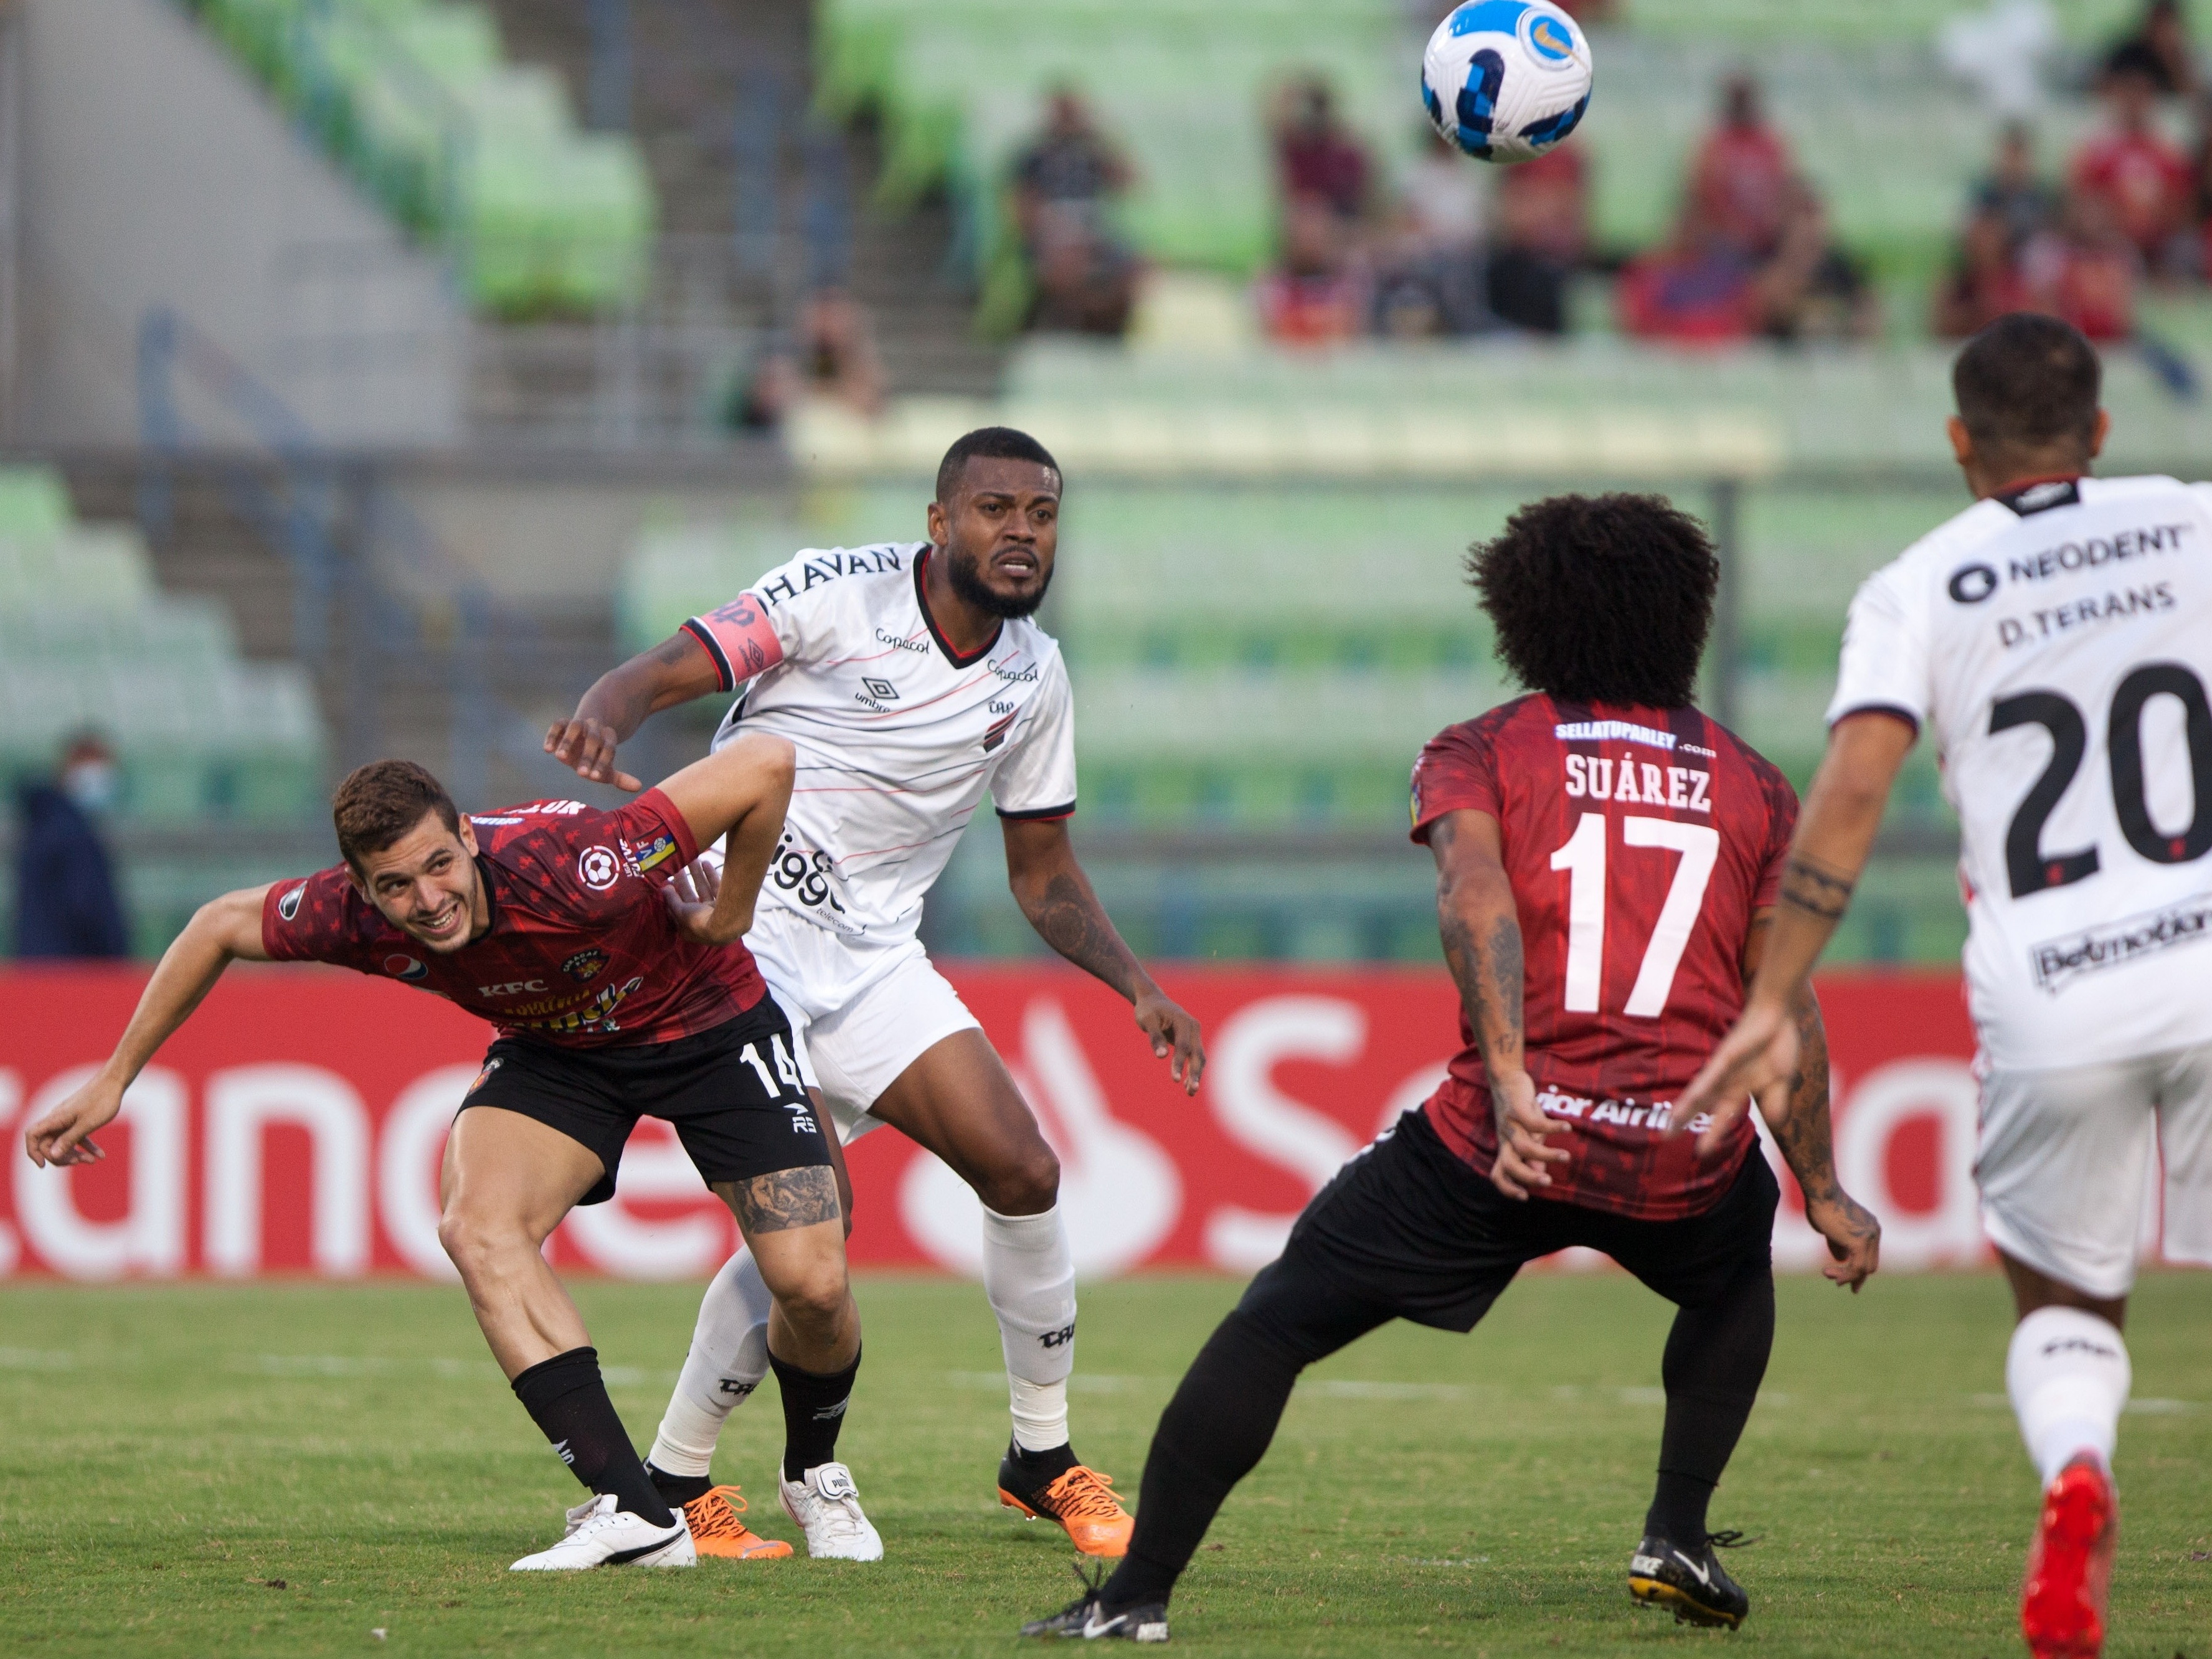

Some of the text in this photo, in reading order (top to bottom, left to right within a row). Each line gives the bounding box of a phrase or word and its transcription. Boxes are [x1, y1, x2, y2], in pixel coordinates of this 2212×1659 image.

[762, 547, 902, 606] HAVAN
[2009, 524, 2190, 582] NEODENT
[876, 627, 929, 655] Copacol
[988, 659, 1040, 682] Copacol
[1565, 751, 1713, 813] SUÁREZ
[1988, 661, 2212, 900] 20
[816, 907, 854, 933] telecom
[1550, 812, 1720, 1018] 17
[478, 979, 549, 997] KFC
[739, 1033, 805, 1099] 14
